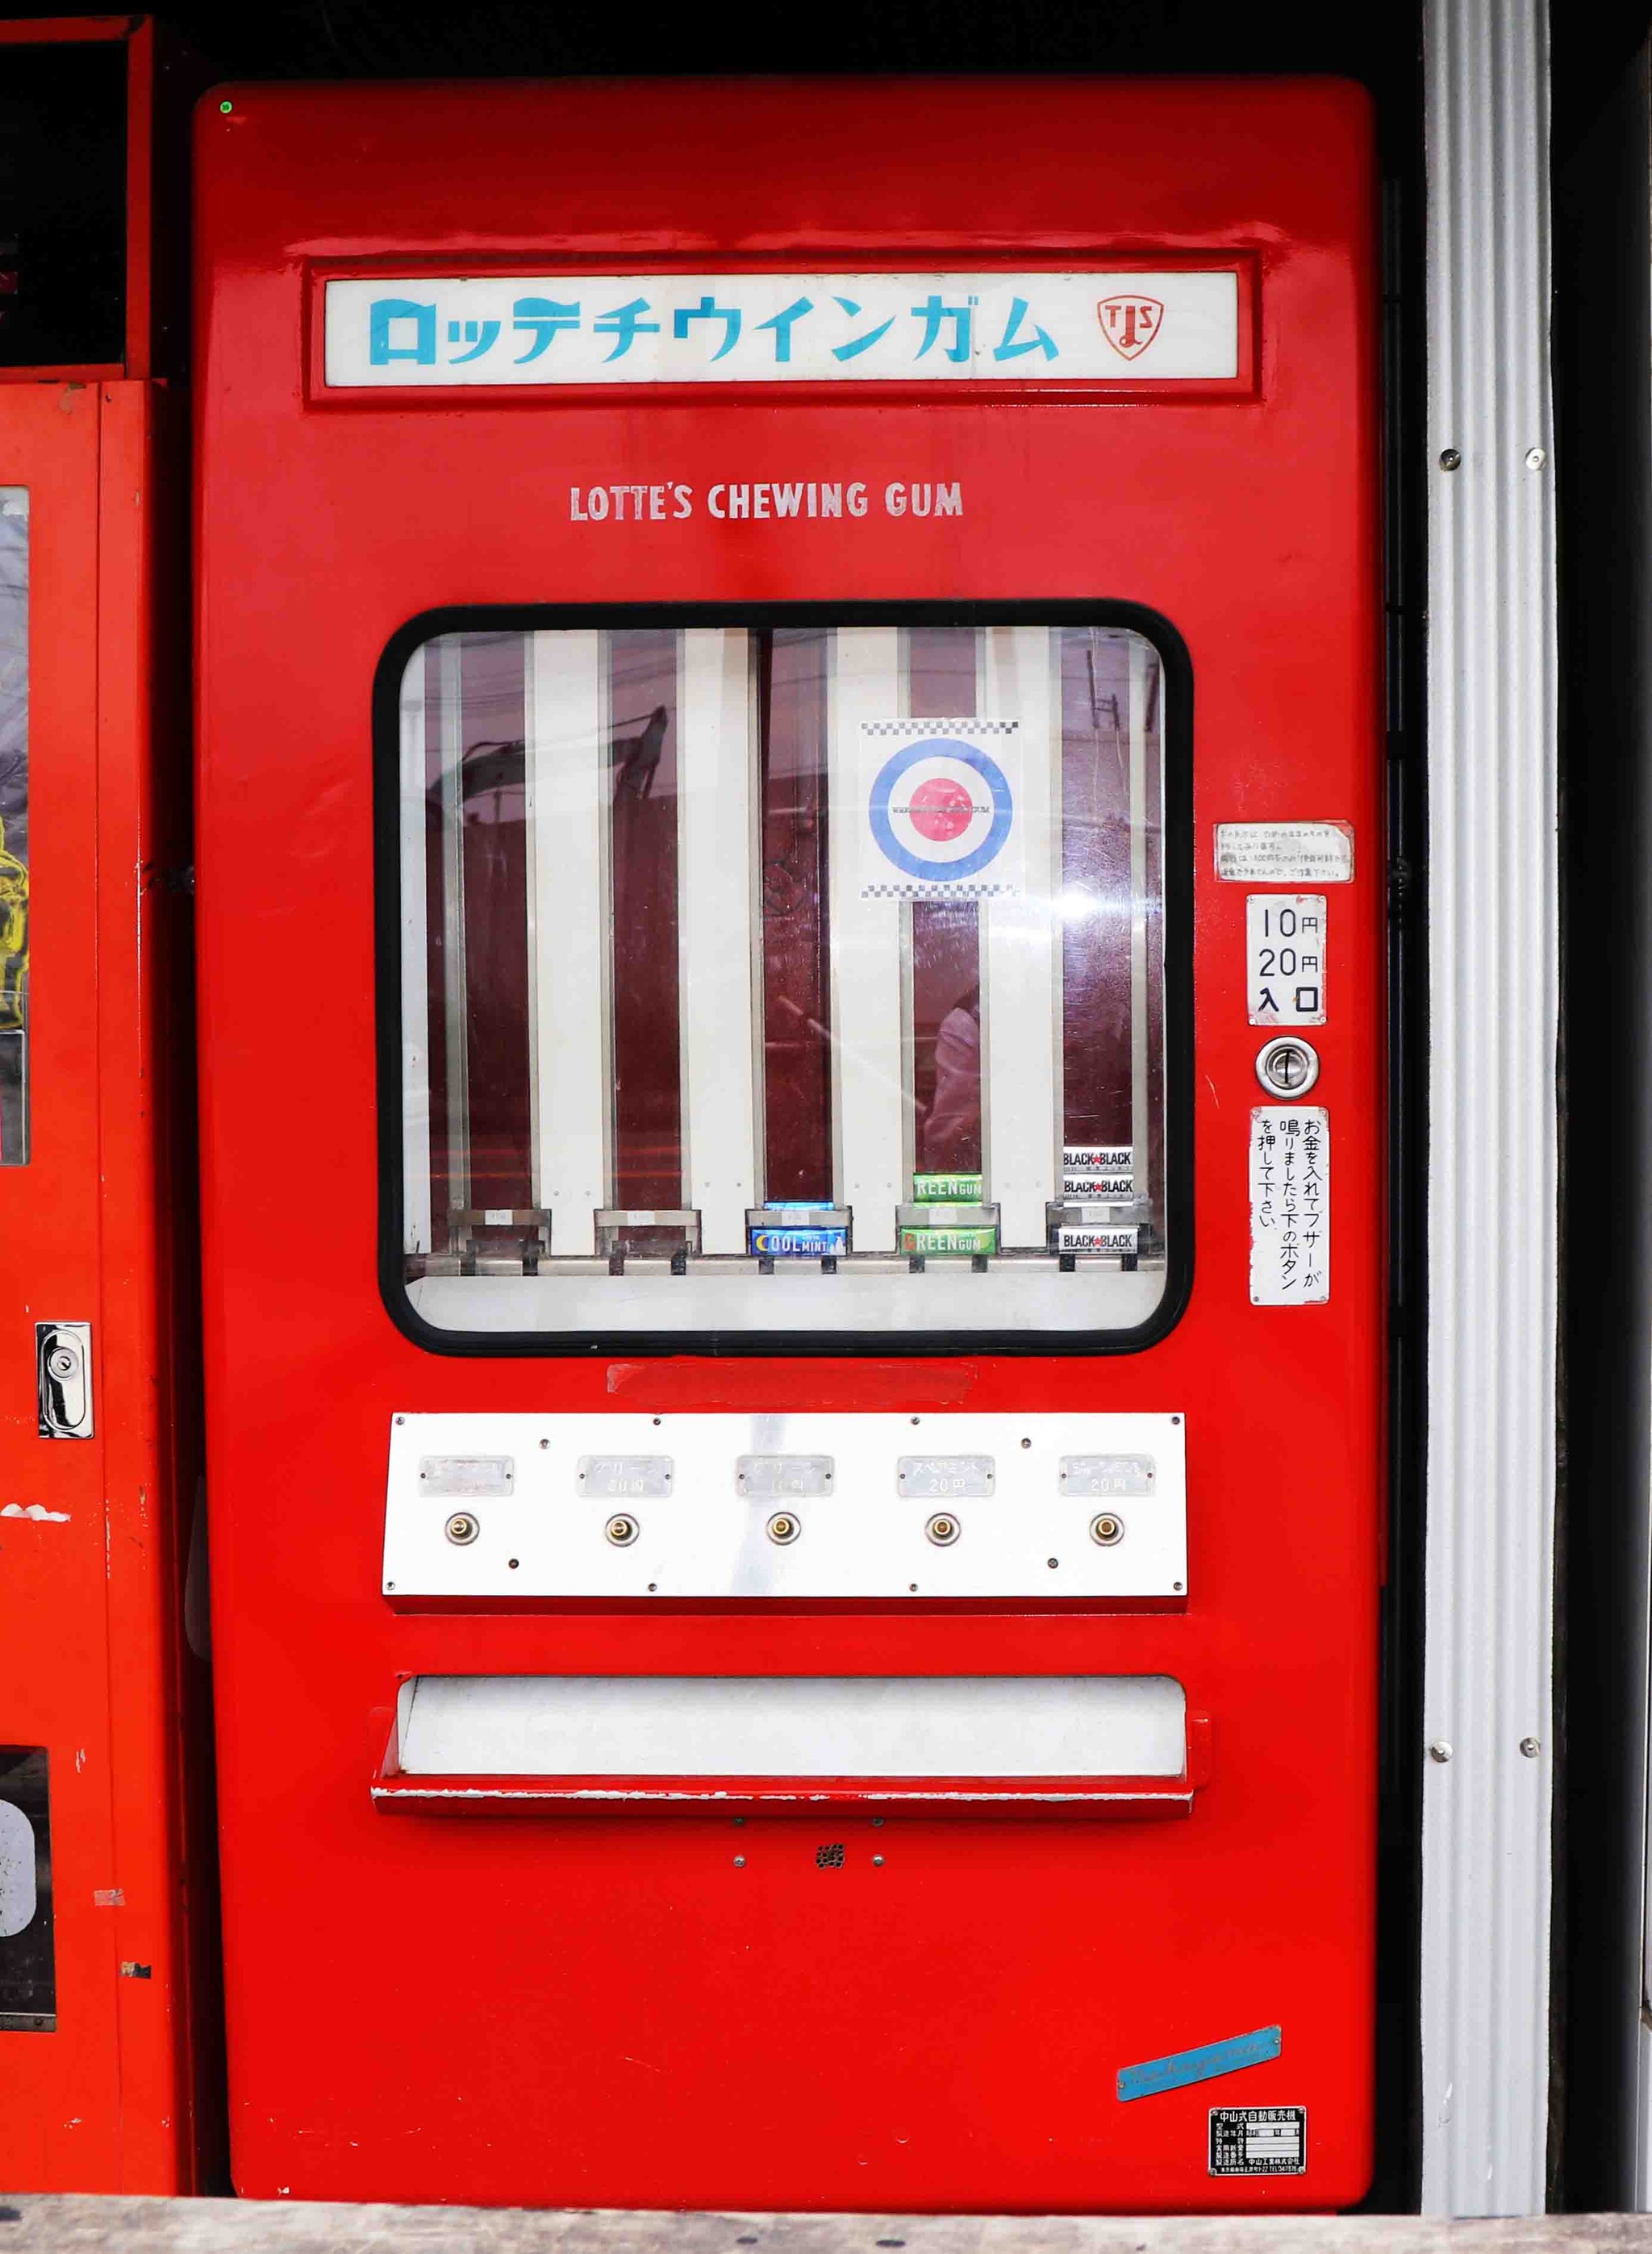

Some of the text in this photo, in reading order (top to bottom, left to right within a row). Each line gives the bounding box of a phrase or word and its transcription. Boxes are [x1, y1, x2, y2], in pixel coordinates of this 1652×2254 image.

[369, 295, 1060, 365] ロッテチウインガム
[570, 482, 964, 522] LOTTE'S CHEWING GUM
[1264, 908, 1317, 937] 10円
[1259, 948, 1318, 976] 20円
[802, 1241, 827, 1252] MINT
[904, 1233, 981, 1250] GREEN GUM
[1220, 2110, 1296, 2123] 中山式自動販売機
